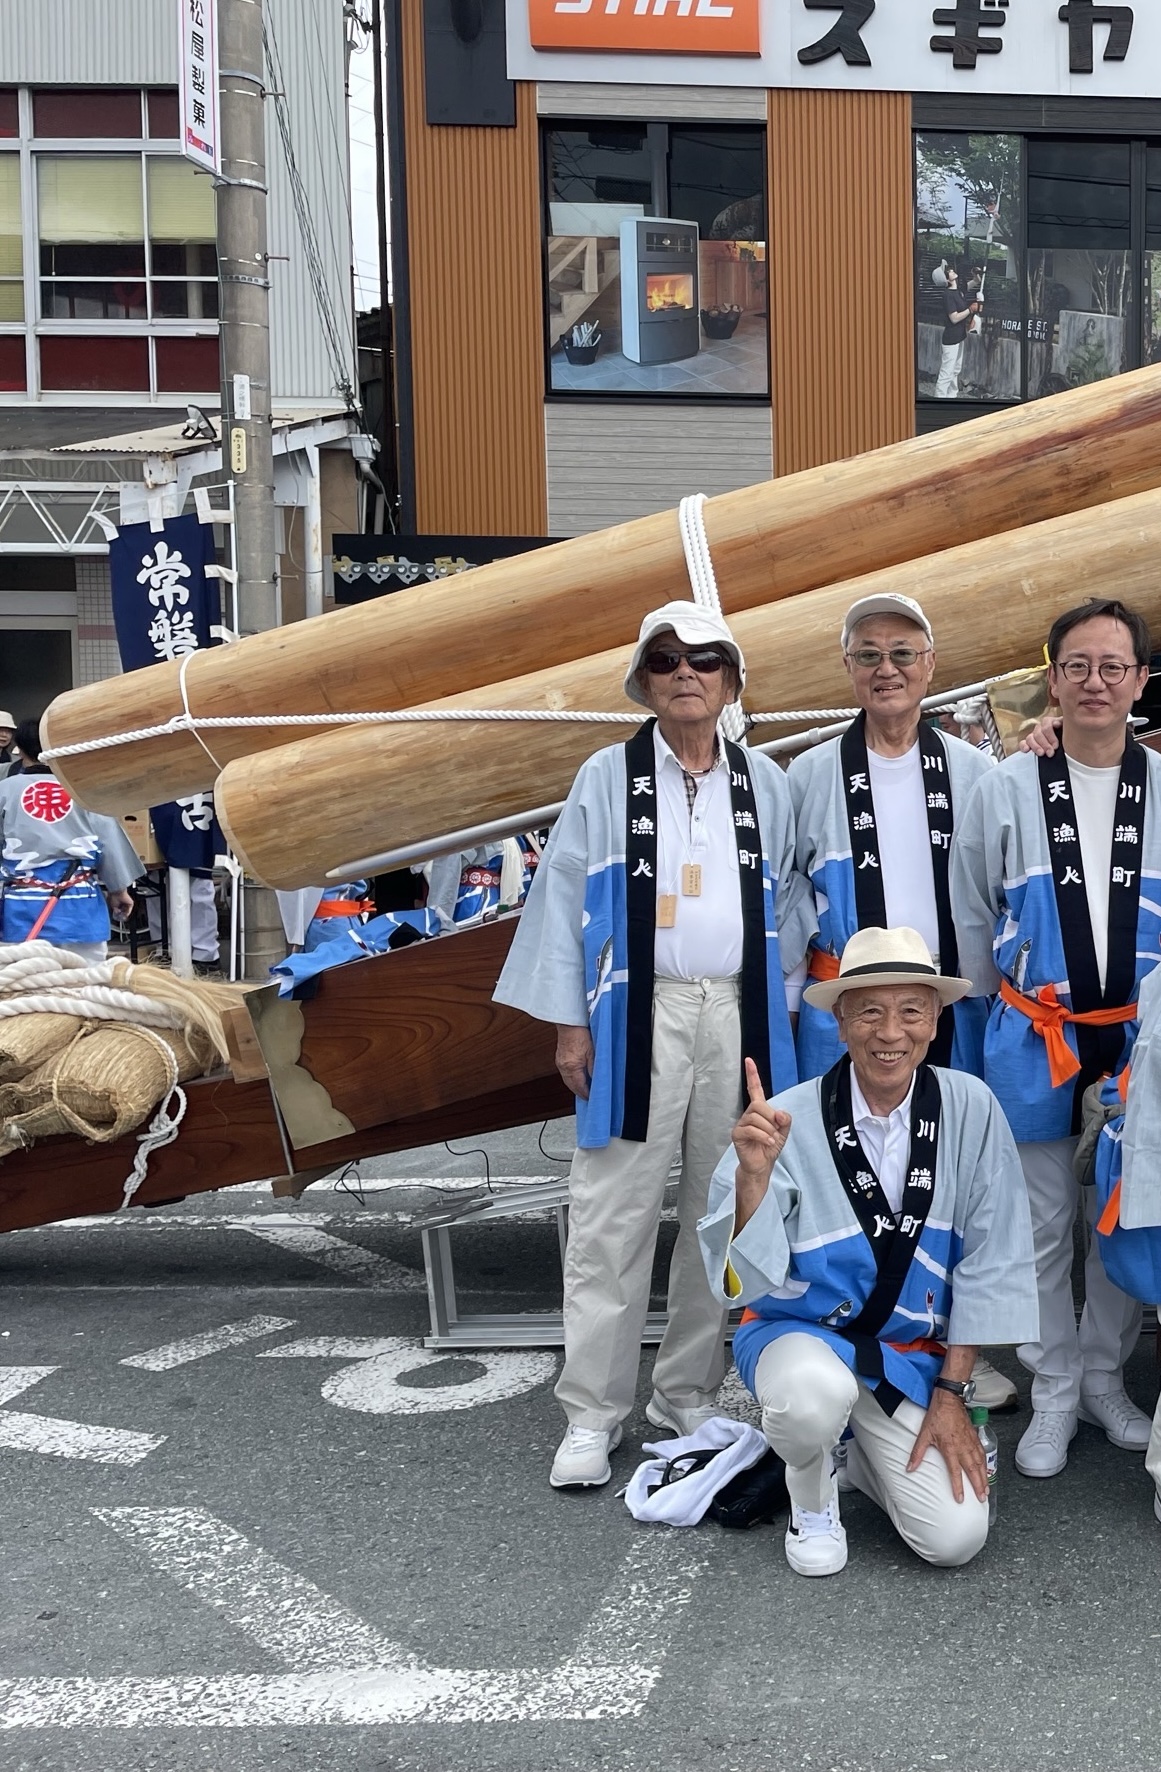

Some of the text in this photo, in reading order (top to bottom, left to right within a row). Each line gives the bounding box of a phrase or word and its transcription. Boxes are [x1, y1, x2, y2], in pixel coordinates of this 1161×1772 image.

[731, 770, 759, 870] 川端町
[922, 755, 951, 850] 川端町
[1111, 782, 1142, 888] 川端町
[900, 1119, 936, 1238] 川端町
